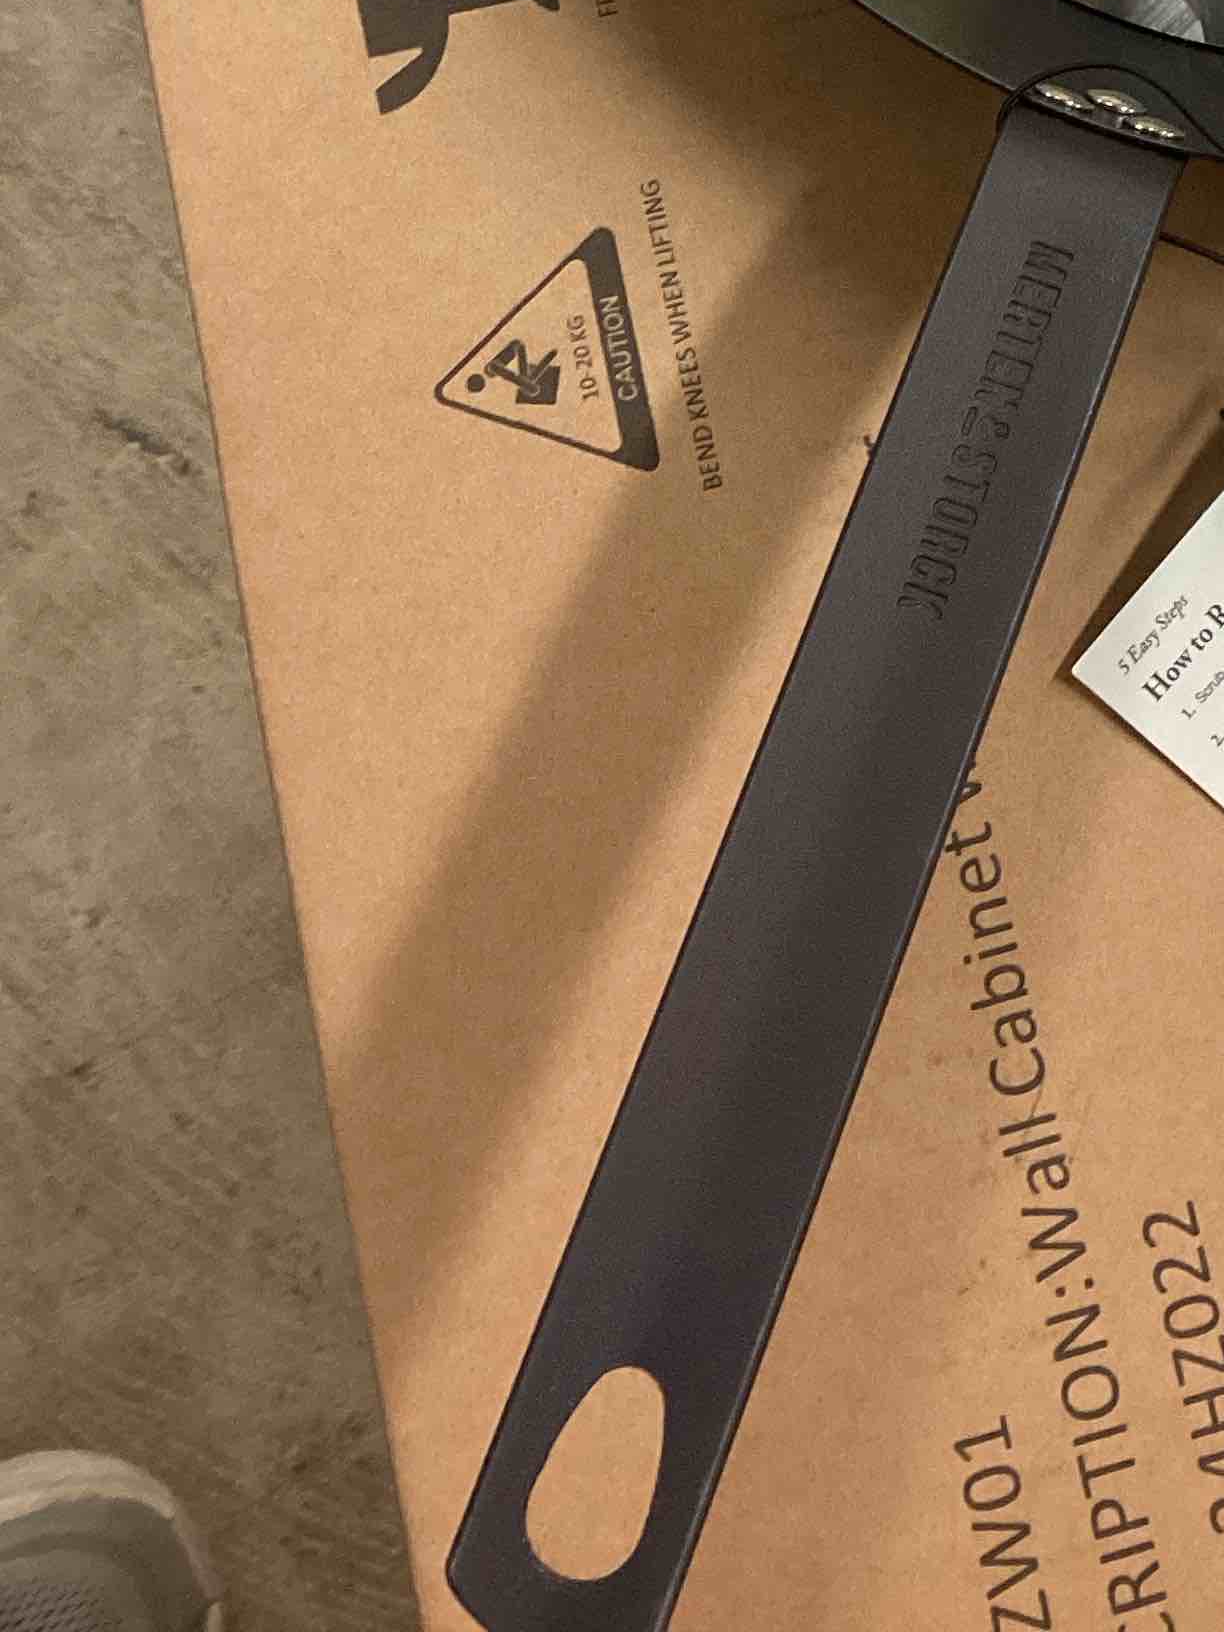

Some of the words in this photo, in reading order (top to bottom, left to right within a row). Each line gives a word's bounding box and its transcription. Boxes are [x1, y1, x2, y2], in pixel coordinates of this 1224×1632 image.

[640, 178, 676, 266] LIFTING
[565, 314, 588, 343] KG
[658, 270, 692, 345] WHEN
[572, 344, 600, 401] 10-20
[599, 295, 638, 401] CAUTION
[675, 347, 709, 421] KNEES
[692, 424, 723, 491] BEND
[1116, 658, 1132, 675] 5
[1126, 629, 1161, 665] Easy
[1155, 595, 1189, 631] Steps
[1141, 650, 1193, 702] How
[1188, 626, 1214, 652] to
[944, 820, 1048, 1097] Cabinet
[952, 1414, 1052, 1632] ZW01
